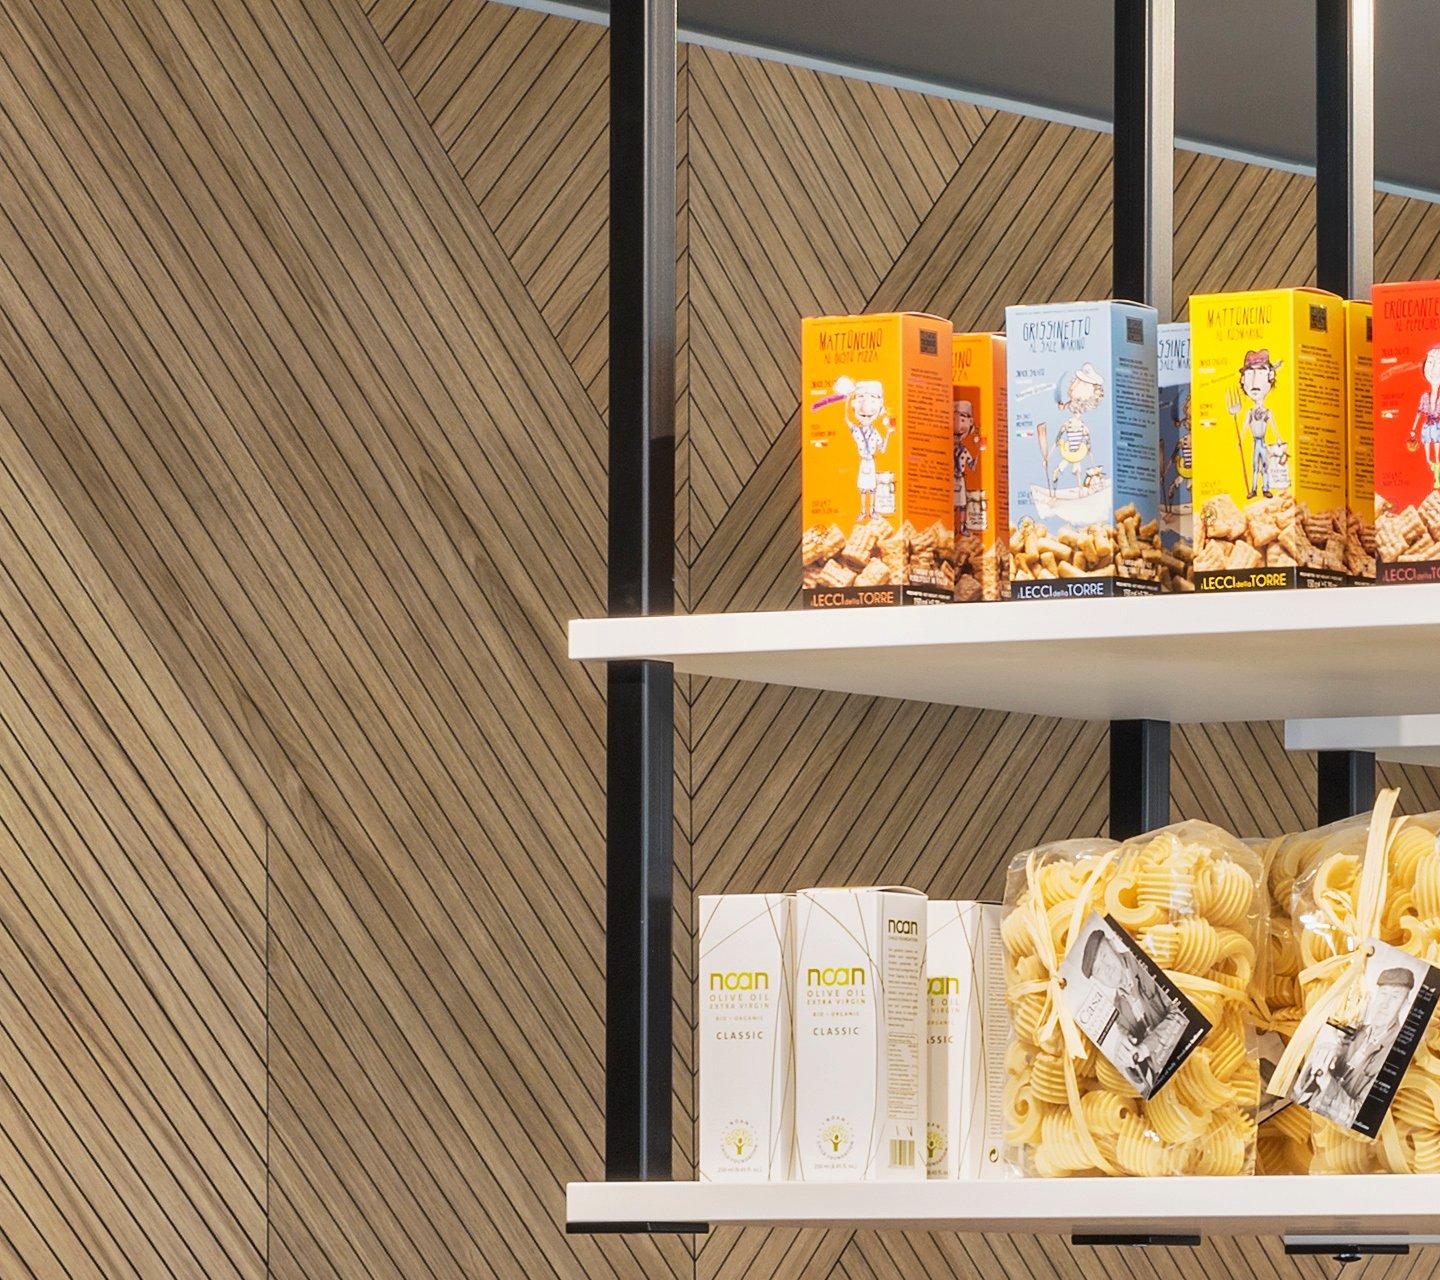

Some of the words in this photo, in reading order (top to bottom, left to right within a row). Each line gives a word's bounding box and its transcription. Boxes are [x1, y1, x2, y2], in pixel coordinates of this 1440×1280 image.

[1023, 316, 1090, 340] GRISSINETTO
[820, 330, 883, 349] MATTONCINO
[1068, 582, 1103, 596] TORRE
[1202, 575, 1235, 590] LECCI
[1250, 573, 1287, 588] TORRE
[710, 972, 768, 990] noan
[807, 967, 864, 986] noan
[717, 1032, 763, 1040] CLASSIC
[814, 1027, 858, 1036] CLASSIC
